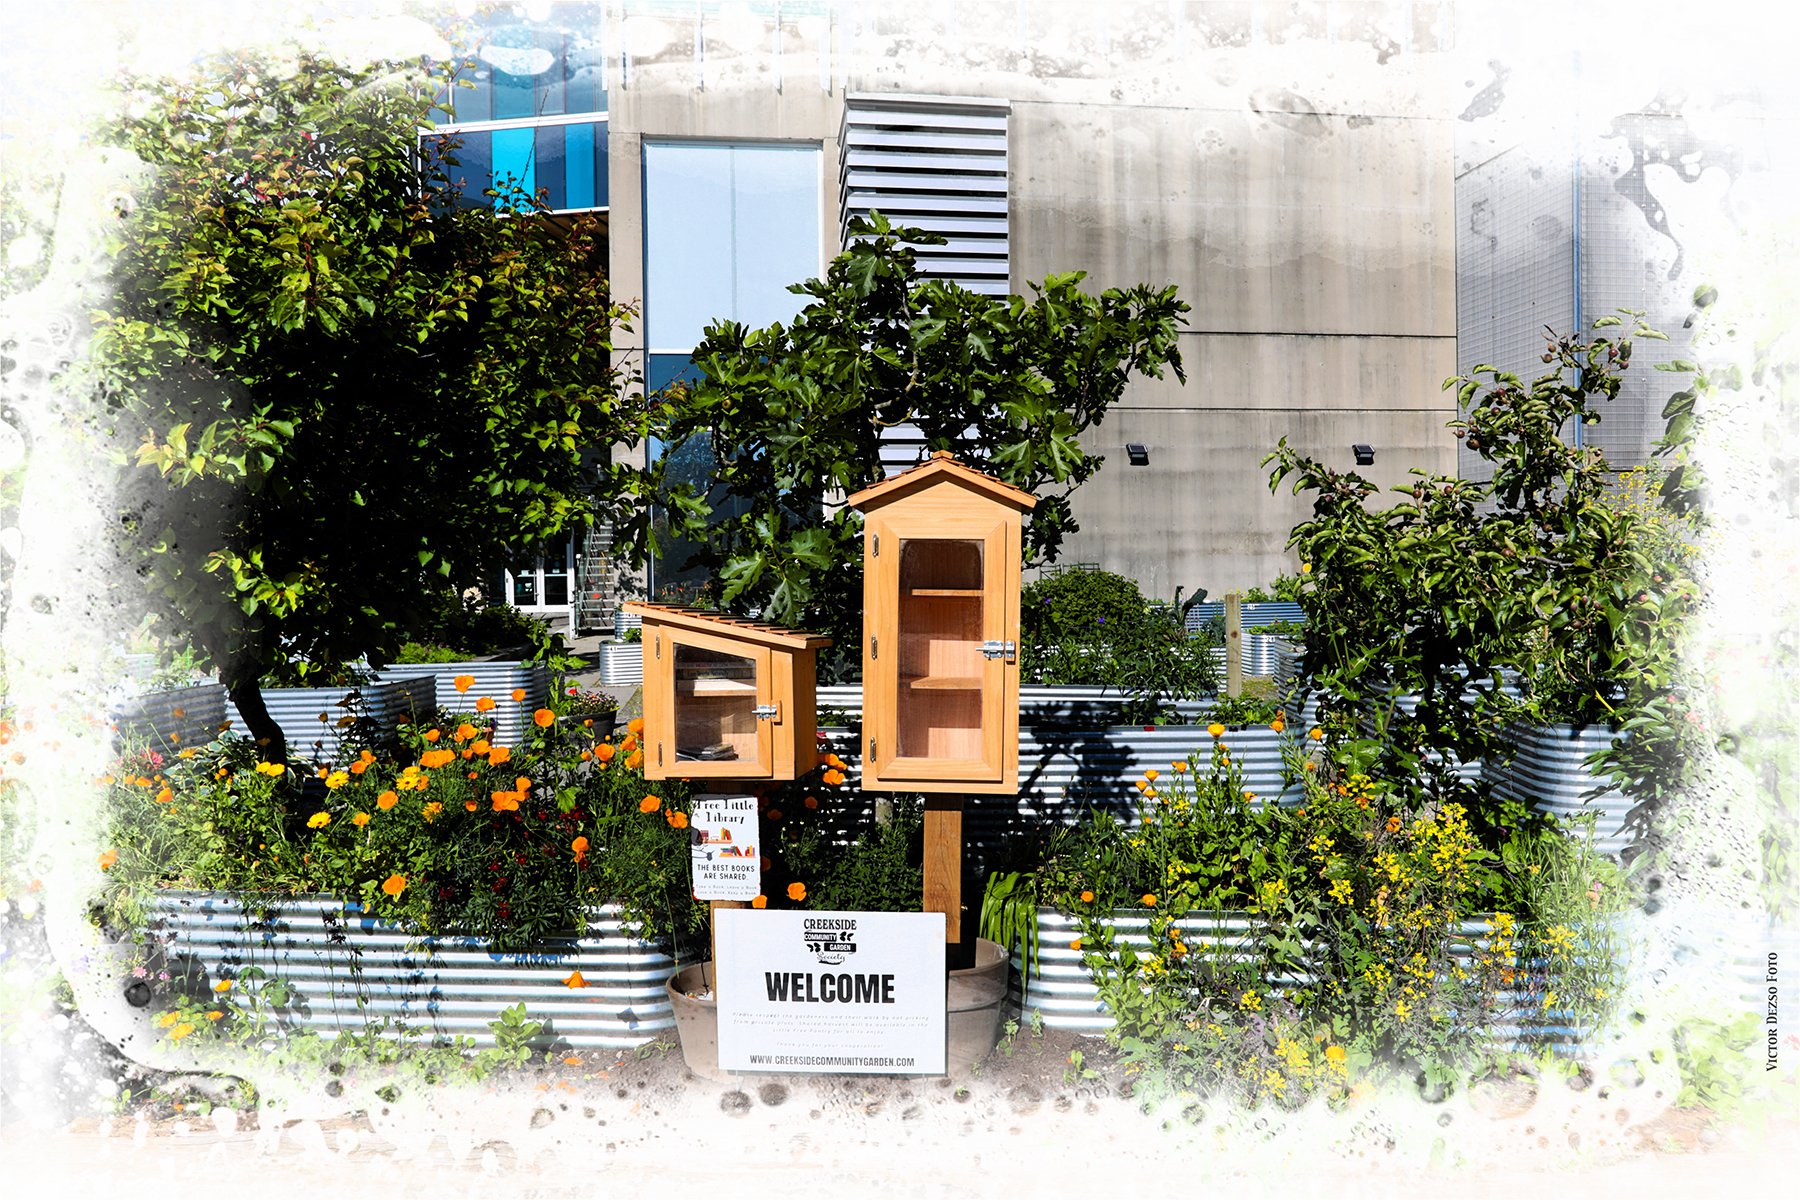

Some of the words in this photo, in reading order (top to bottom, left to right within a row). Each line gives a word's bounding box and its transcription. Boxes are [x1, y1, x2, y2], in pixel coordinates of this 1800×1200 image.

[697, 863, 709, 871] THE
[712, 864, 729, 872] BEST
[703, 872, 717, 880] ARE
[719, 873, 749, 881] SHARED.
[803, 918, 857, 930] CREEKSIDE
[804, 933, 837, 941] COMMUNITY
[829, 943, 851, 951] GARDEN
[764, 972, 895, 1004] WELCOME
[749, 1054, 915, 1067] WWW.CREEKSIDECOMMUNITYGARDEN.COM
